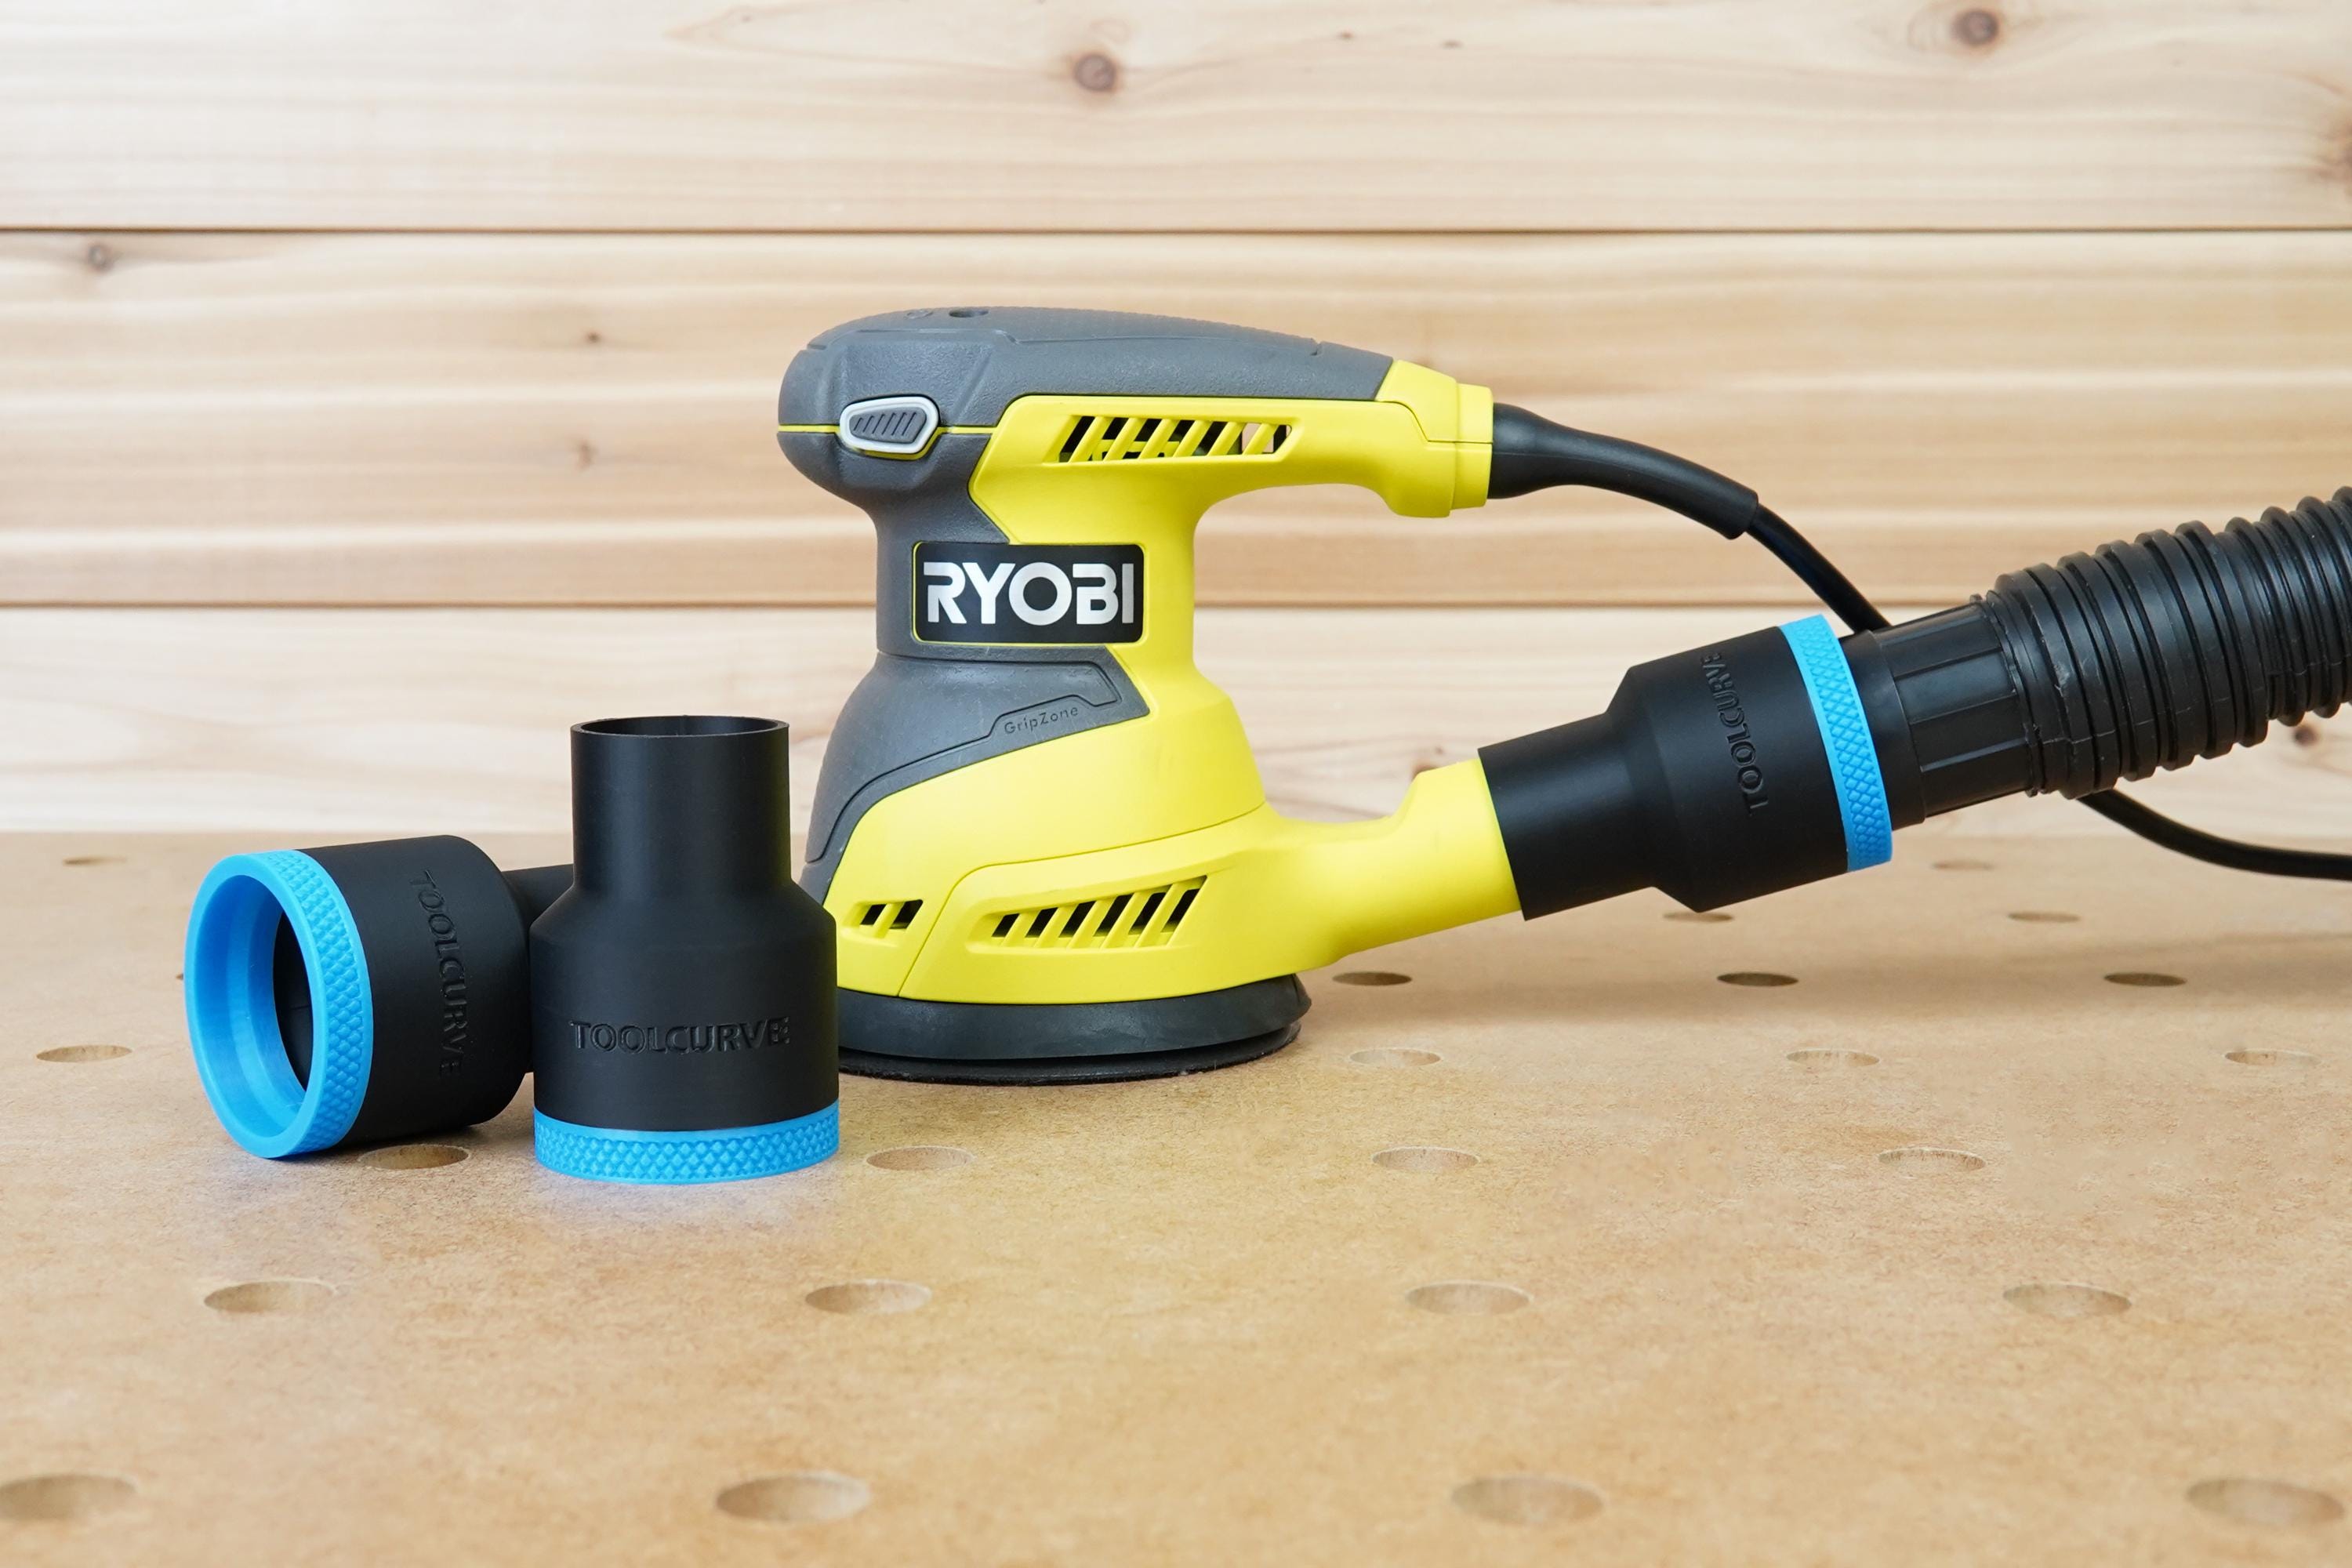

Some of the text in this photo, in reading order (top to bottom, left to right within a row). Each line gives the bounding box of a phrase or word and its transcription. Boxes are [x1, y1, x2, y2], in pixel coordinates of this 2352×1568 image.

[924, 561, 1134, 626] RYOBI
[1004, 707, 1078, 734] GripZone
[1700, 652, 1769, 817] TOOLCURVE
[408, 869, 468, 1078] TOOLCURVE
[568, 1017, 789, 1054] TOOLCURVE
